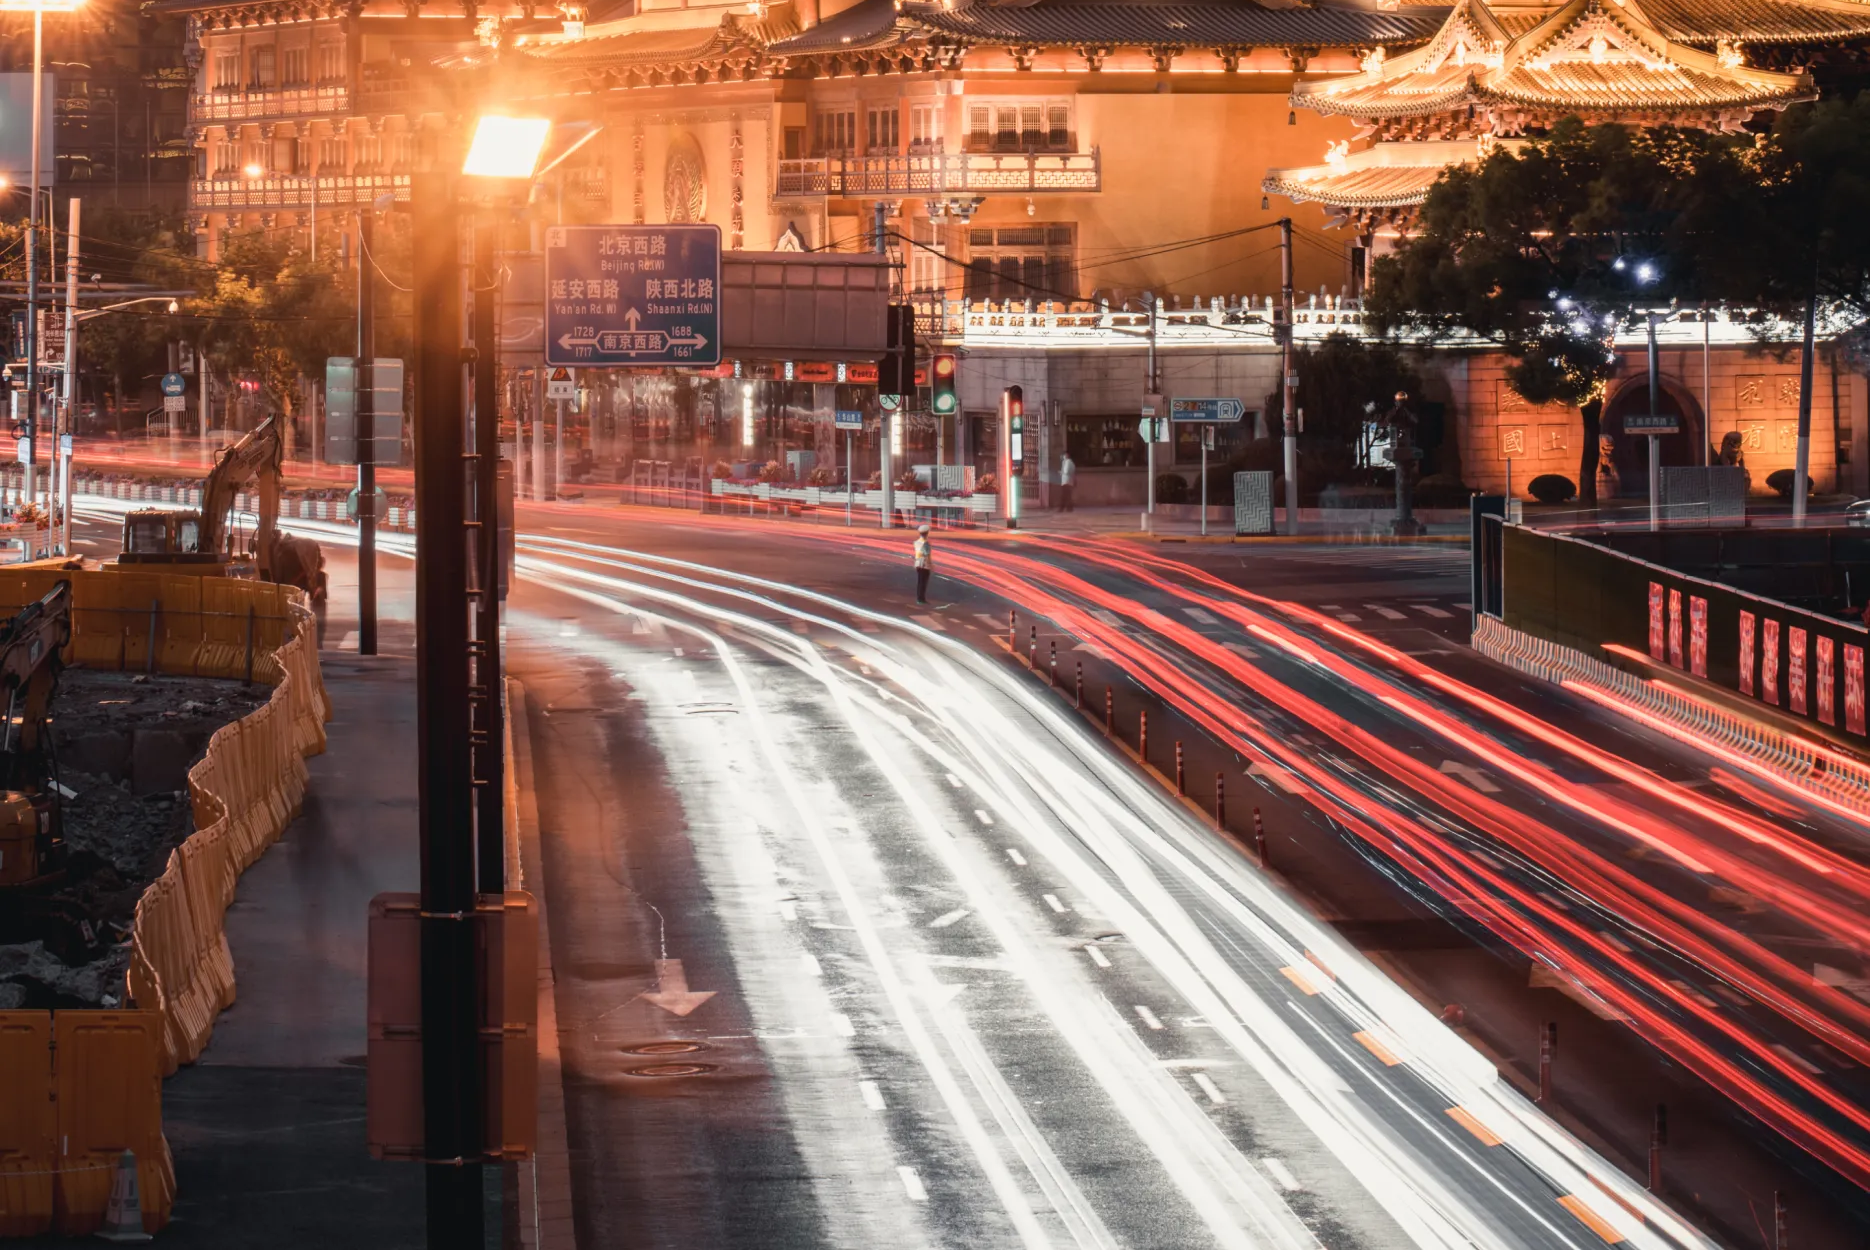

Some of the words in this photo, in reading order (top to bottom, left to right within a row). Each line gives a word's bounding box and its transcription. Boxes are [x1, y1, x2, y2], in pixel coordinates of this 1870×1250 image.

[599, 235, 666, 255] 北京西路
[601, 259, 634, 273] Beijing
[551, 279, 620, 299] 延安西路
[646, 279, 714, 299] 陕西北路
[555, 304, 587, 314] Yan'an
[647, 304, 685, 314] Shaanxi
[688, 304, 713, 314] Rd.(N)
[574, 327, 594, 337] 1728
[671, 326, 692, 336] 1688
[604, 334, 662, 349] 南京西路
[575, 347, 592, 357] 1717
[674, 347, 692, 357] 1661
